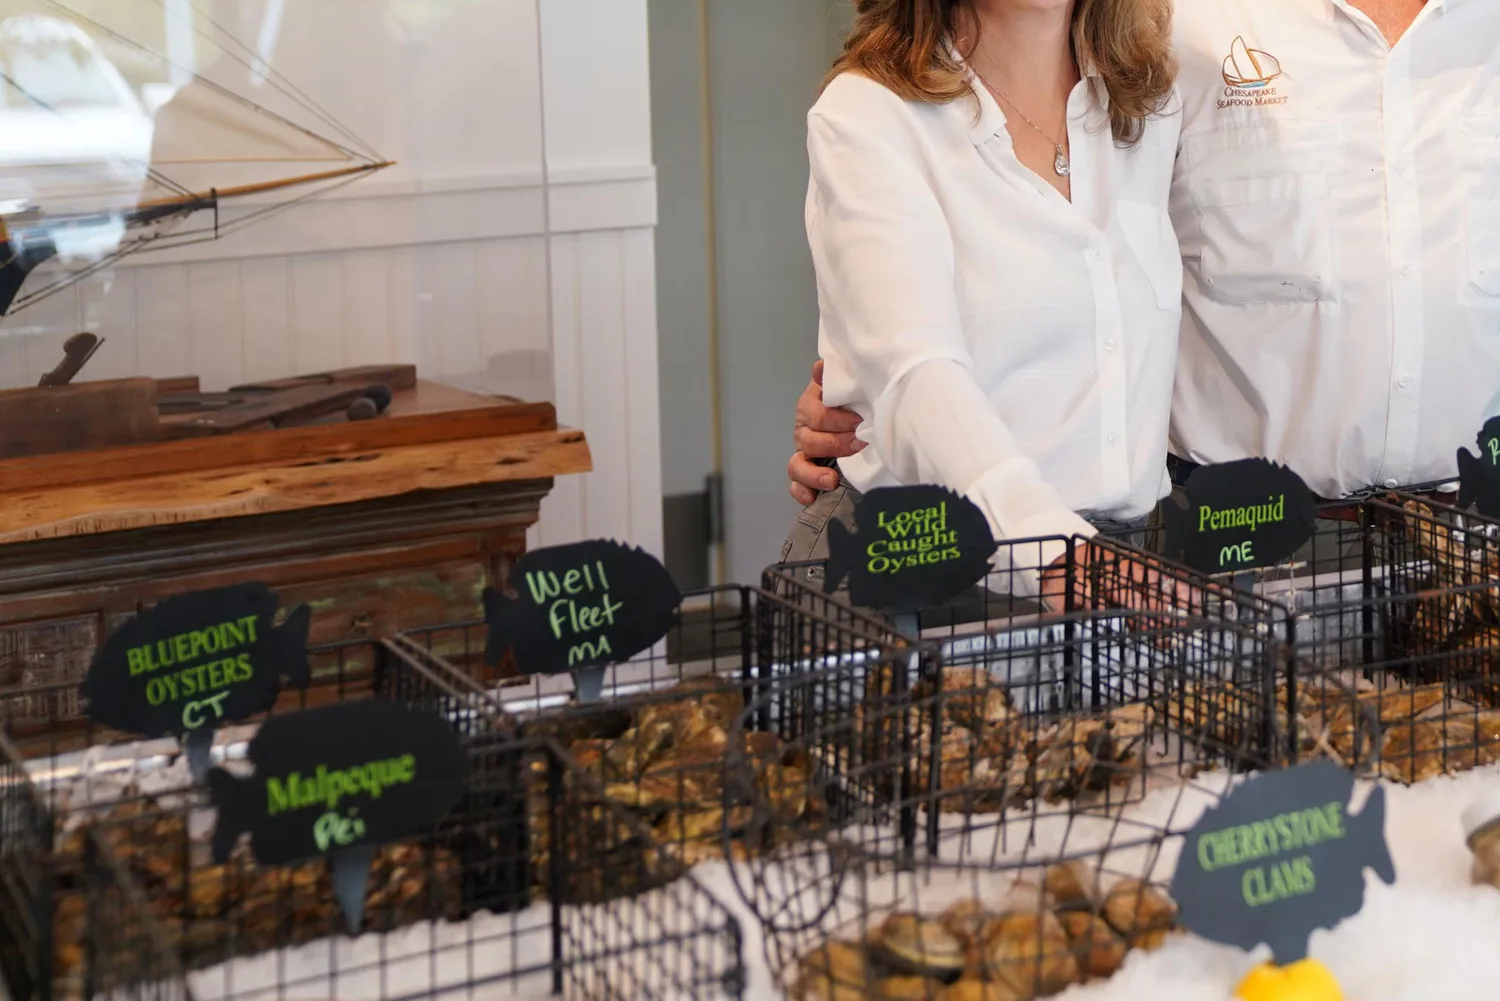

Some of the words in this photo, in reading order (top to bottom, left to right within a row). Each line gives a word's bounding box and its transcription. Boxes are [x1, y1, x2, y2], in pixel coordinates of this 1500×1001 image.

[1216, 98, 1254, 110] SEAFOOD
[1254, 95, 1289, 107] MARKET
[877, 501, 947, 528] Local
[885, 513, 946, 540] Wild
[1198, 493, 1285, 532] Pemaquid
[866, 529, 958, 558] Caught
[866, 546, 962, 575] Oysters
[1219, 540, 1255, 567] ME
[525, 560, 610, 605] Well
[548, 593, 624, 639] Fleet
[126, 614, 260, 677] BLUEPOINT
[145, 652, 254, 707] OYSTERS
[182, 690, 231, 730] CT
[265, 752, 417, 817] Malpeque
[1197, 801, 1347, 872] CHERRYSTONE
[1241, 854, 1317, 908] CLAMS
